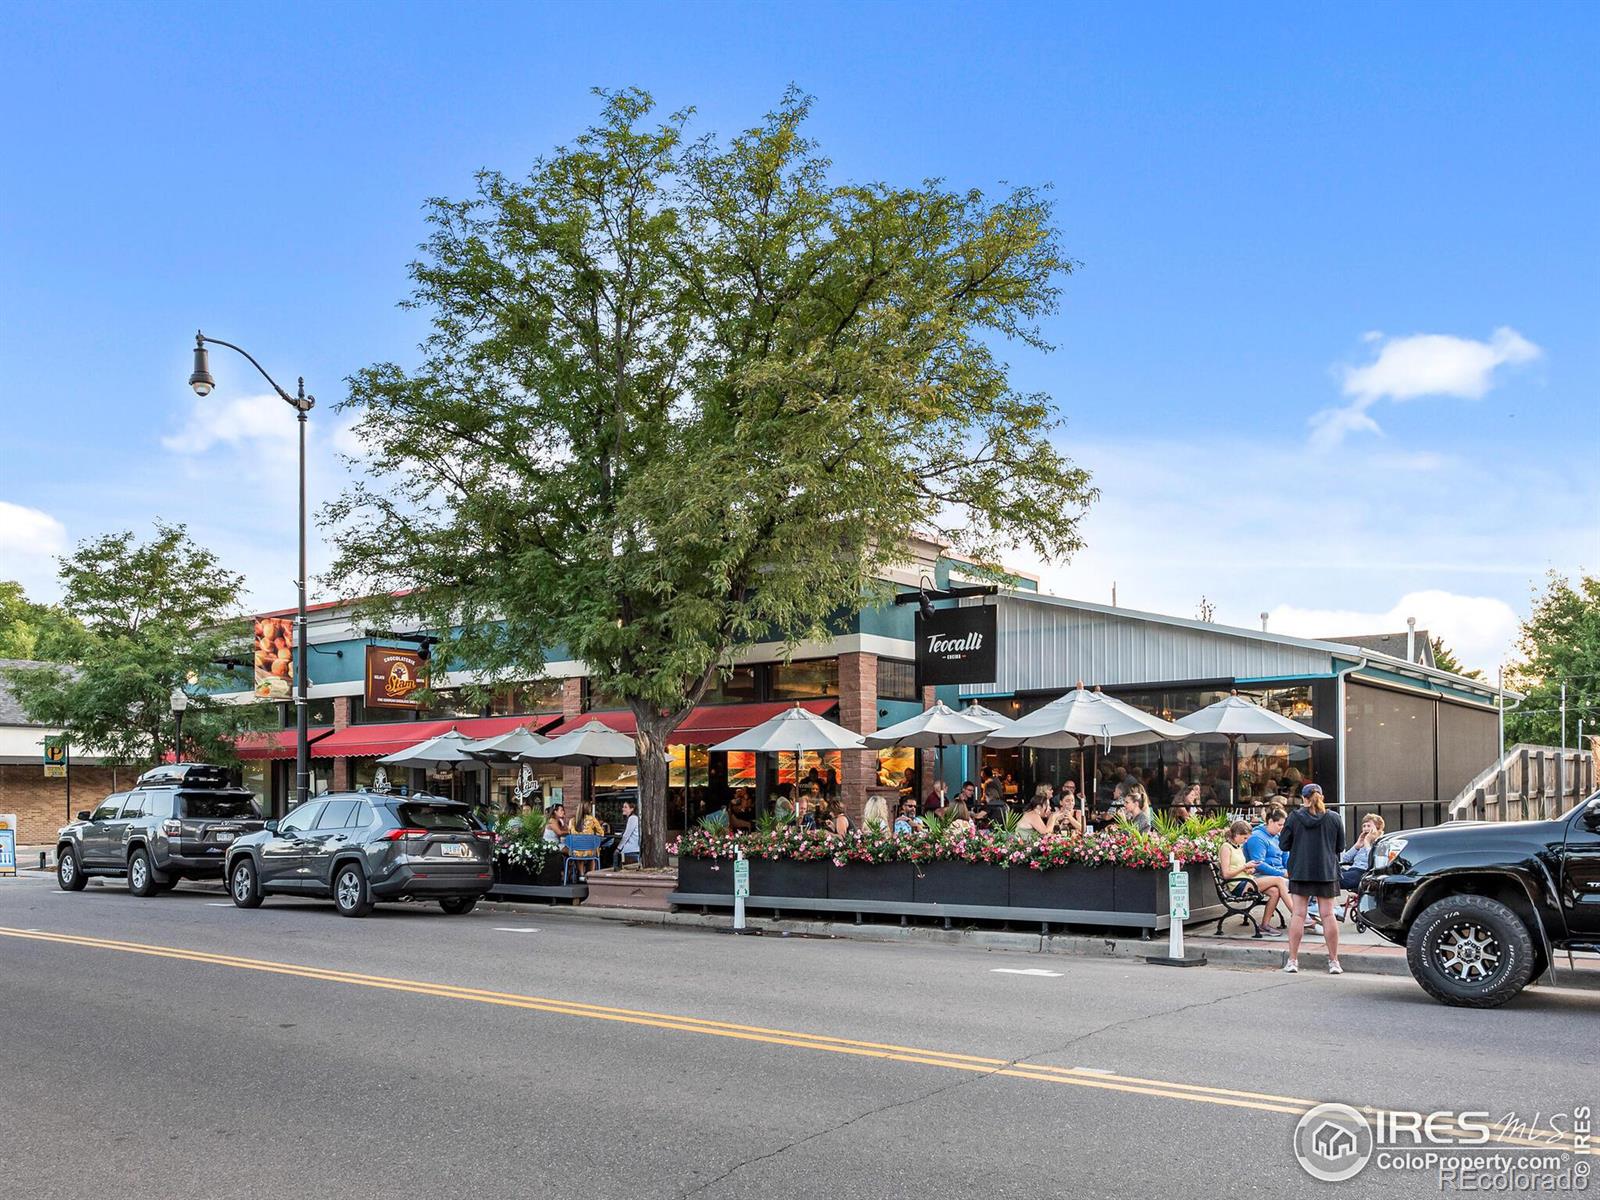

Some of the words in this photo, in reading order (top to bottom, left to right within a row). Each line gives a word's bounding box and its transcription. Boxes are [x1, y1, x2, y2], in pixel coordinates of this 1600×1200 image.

[927, 631, 983, 653] Teocalli
[385, 675, 417, 693] Stam
[50, 746, 62, 760] P
